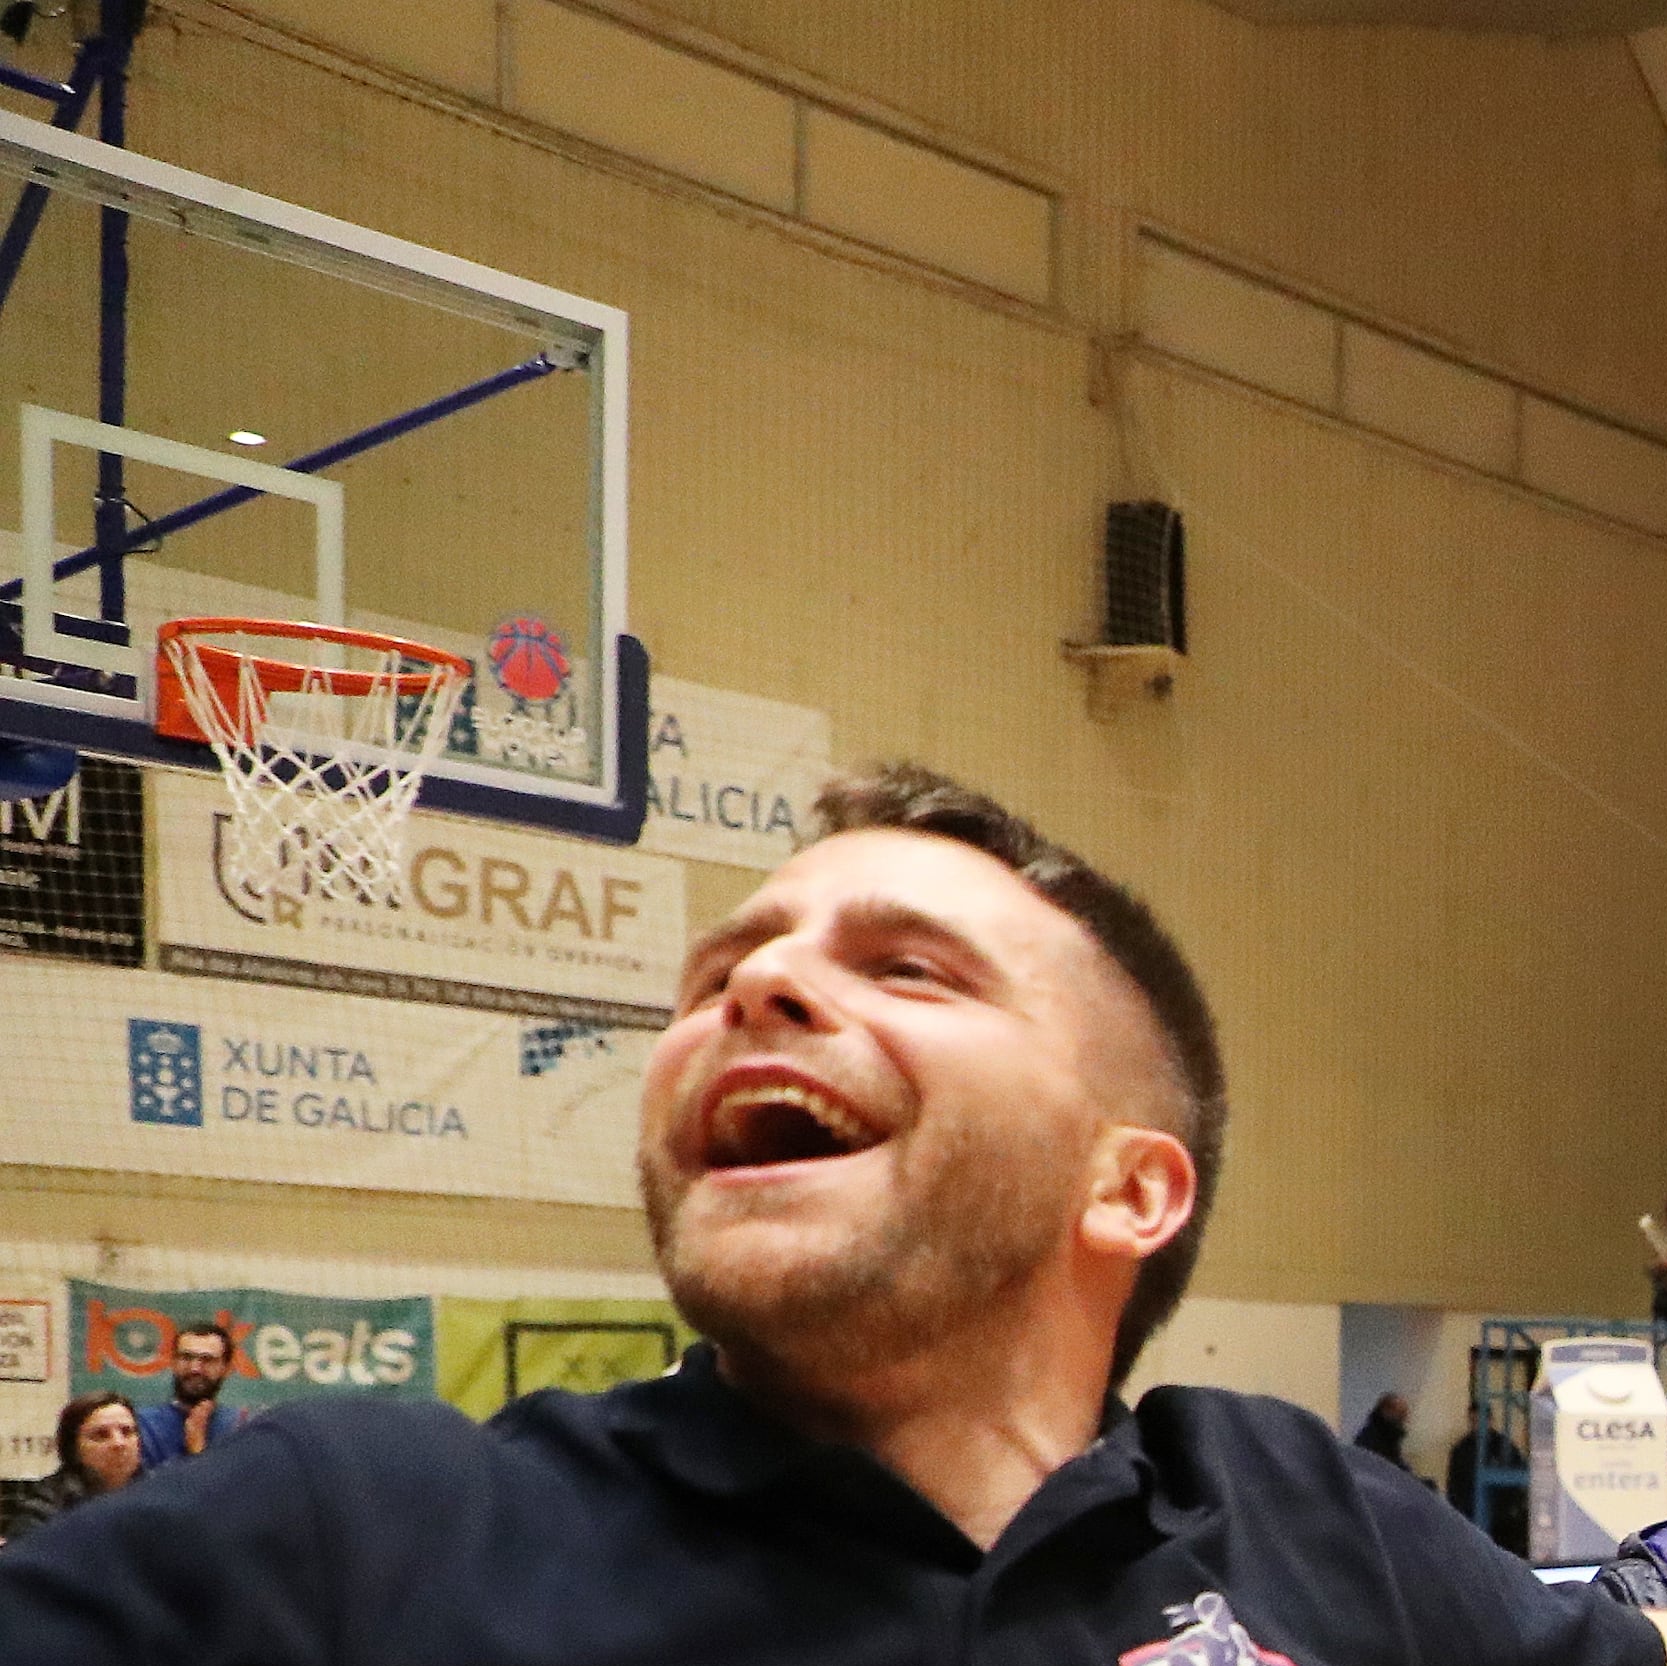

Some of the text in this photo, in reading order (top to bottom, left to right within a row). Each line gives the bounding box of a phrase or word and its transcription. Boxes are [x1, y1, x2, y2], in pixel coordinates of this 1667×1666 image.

[222, 1037, 377, 1086] XUNTA
[222, 1085, 469, 1140] DE GALICIA
